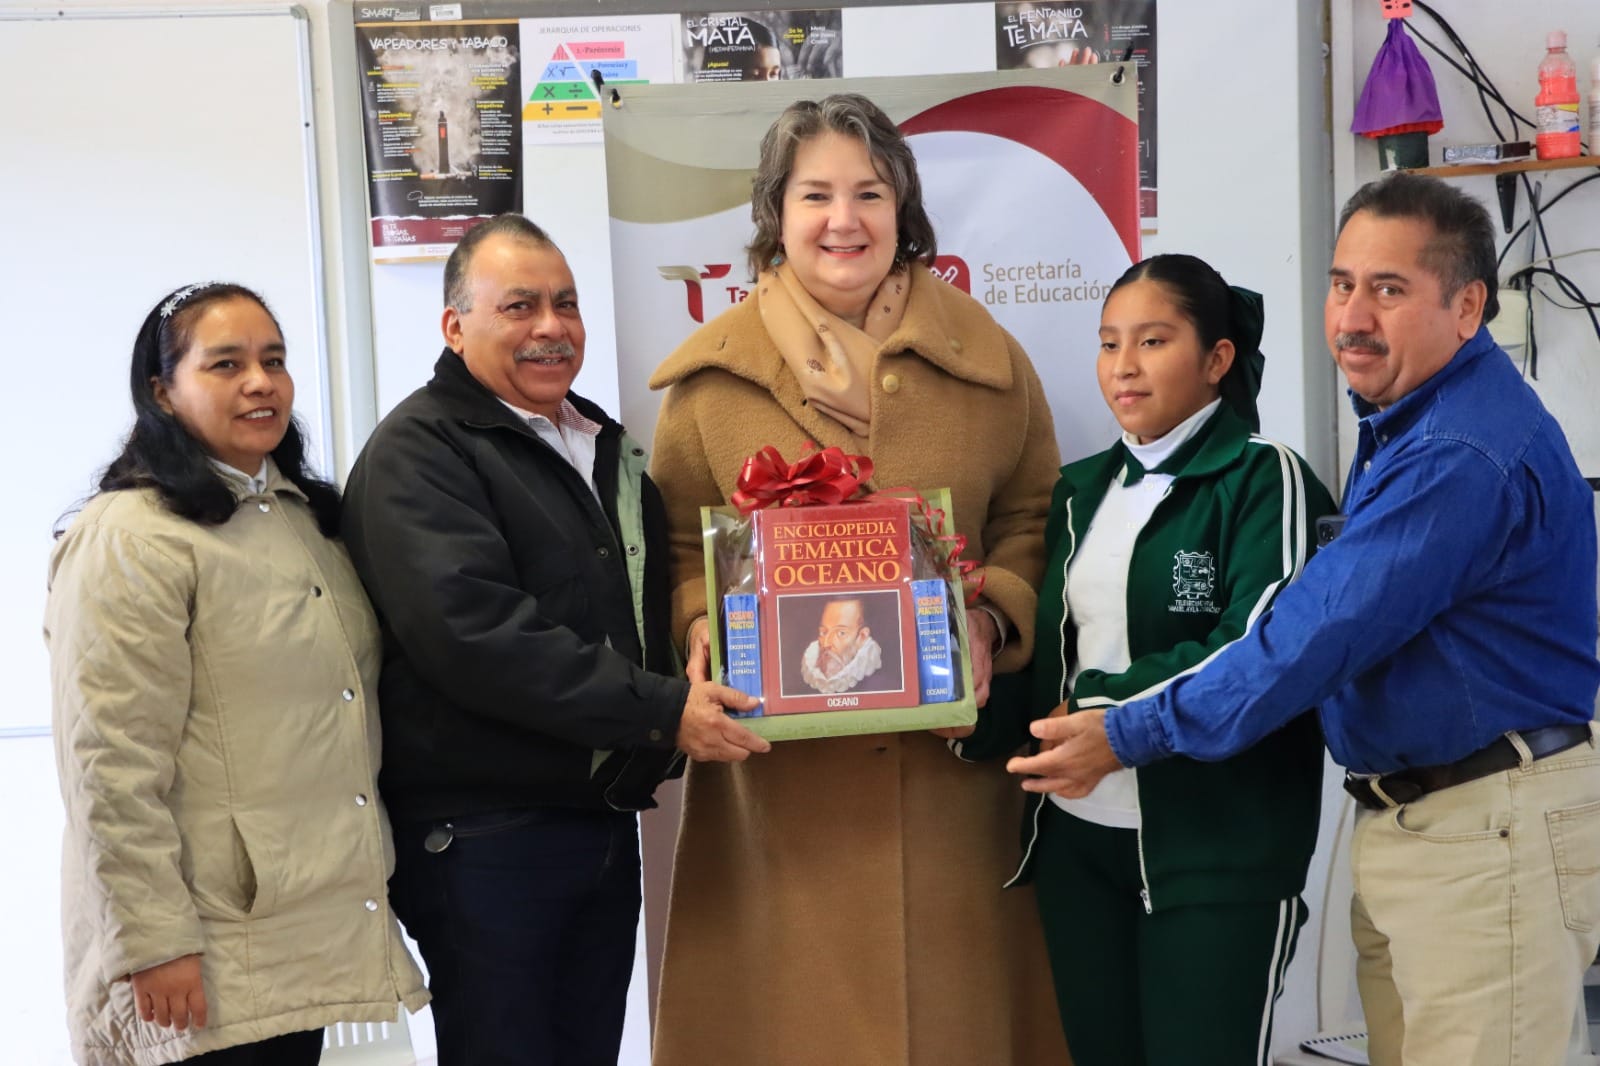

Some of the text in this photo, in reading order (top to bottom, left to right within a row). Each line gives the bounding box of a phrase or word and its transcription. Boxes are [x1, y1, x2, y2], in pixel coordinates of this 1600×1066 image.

[361, 8, 393, 18] SMART
[1019, 7, 1083, 25] FENTANILO
[592, 24, 641, 33] OPERACIONES
[687, 17, 747, 28] EL CRISTAL
[687, 27, 755, 47] MATA
[1003, 25, 1026, 47] TE
[1030, 20, 1088, 40] MATA
[369, 37, 447, 50] VAPEADORES
[460, 36, 508, 49] TABACO
[983, 258, 1081, 282] Secretaría
[984, 284, 1008, 305] de
[773, 521, 897, 539] ENCICLOPEDIA
[774, 538, 899, 560] TEMATICA
[773, 560, 901, 587] OCEANO
[926, 687, 948, 696] OCEANO
[827, 697, 859, 708] OCEANO
